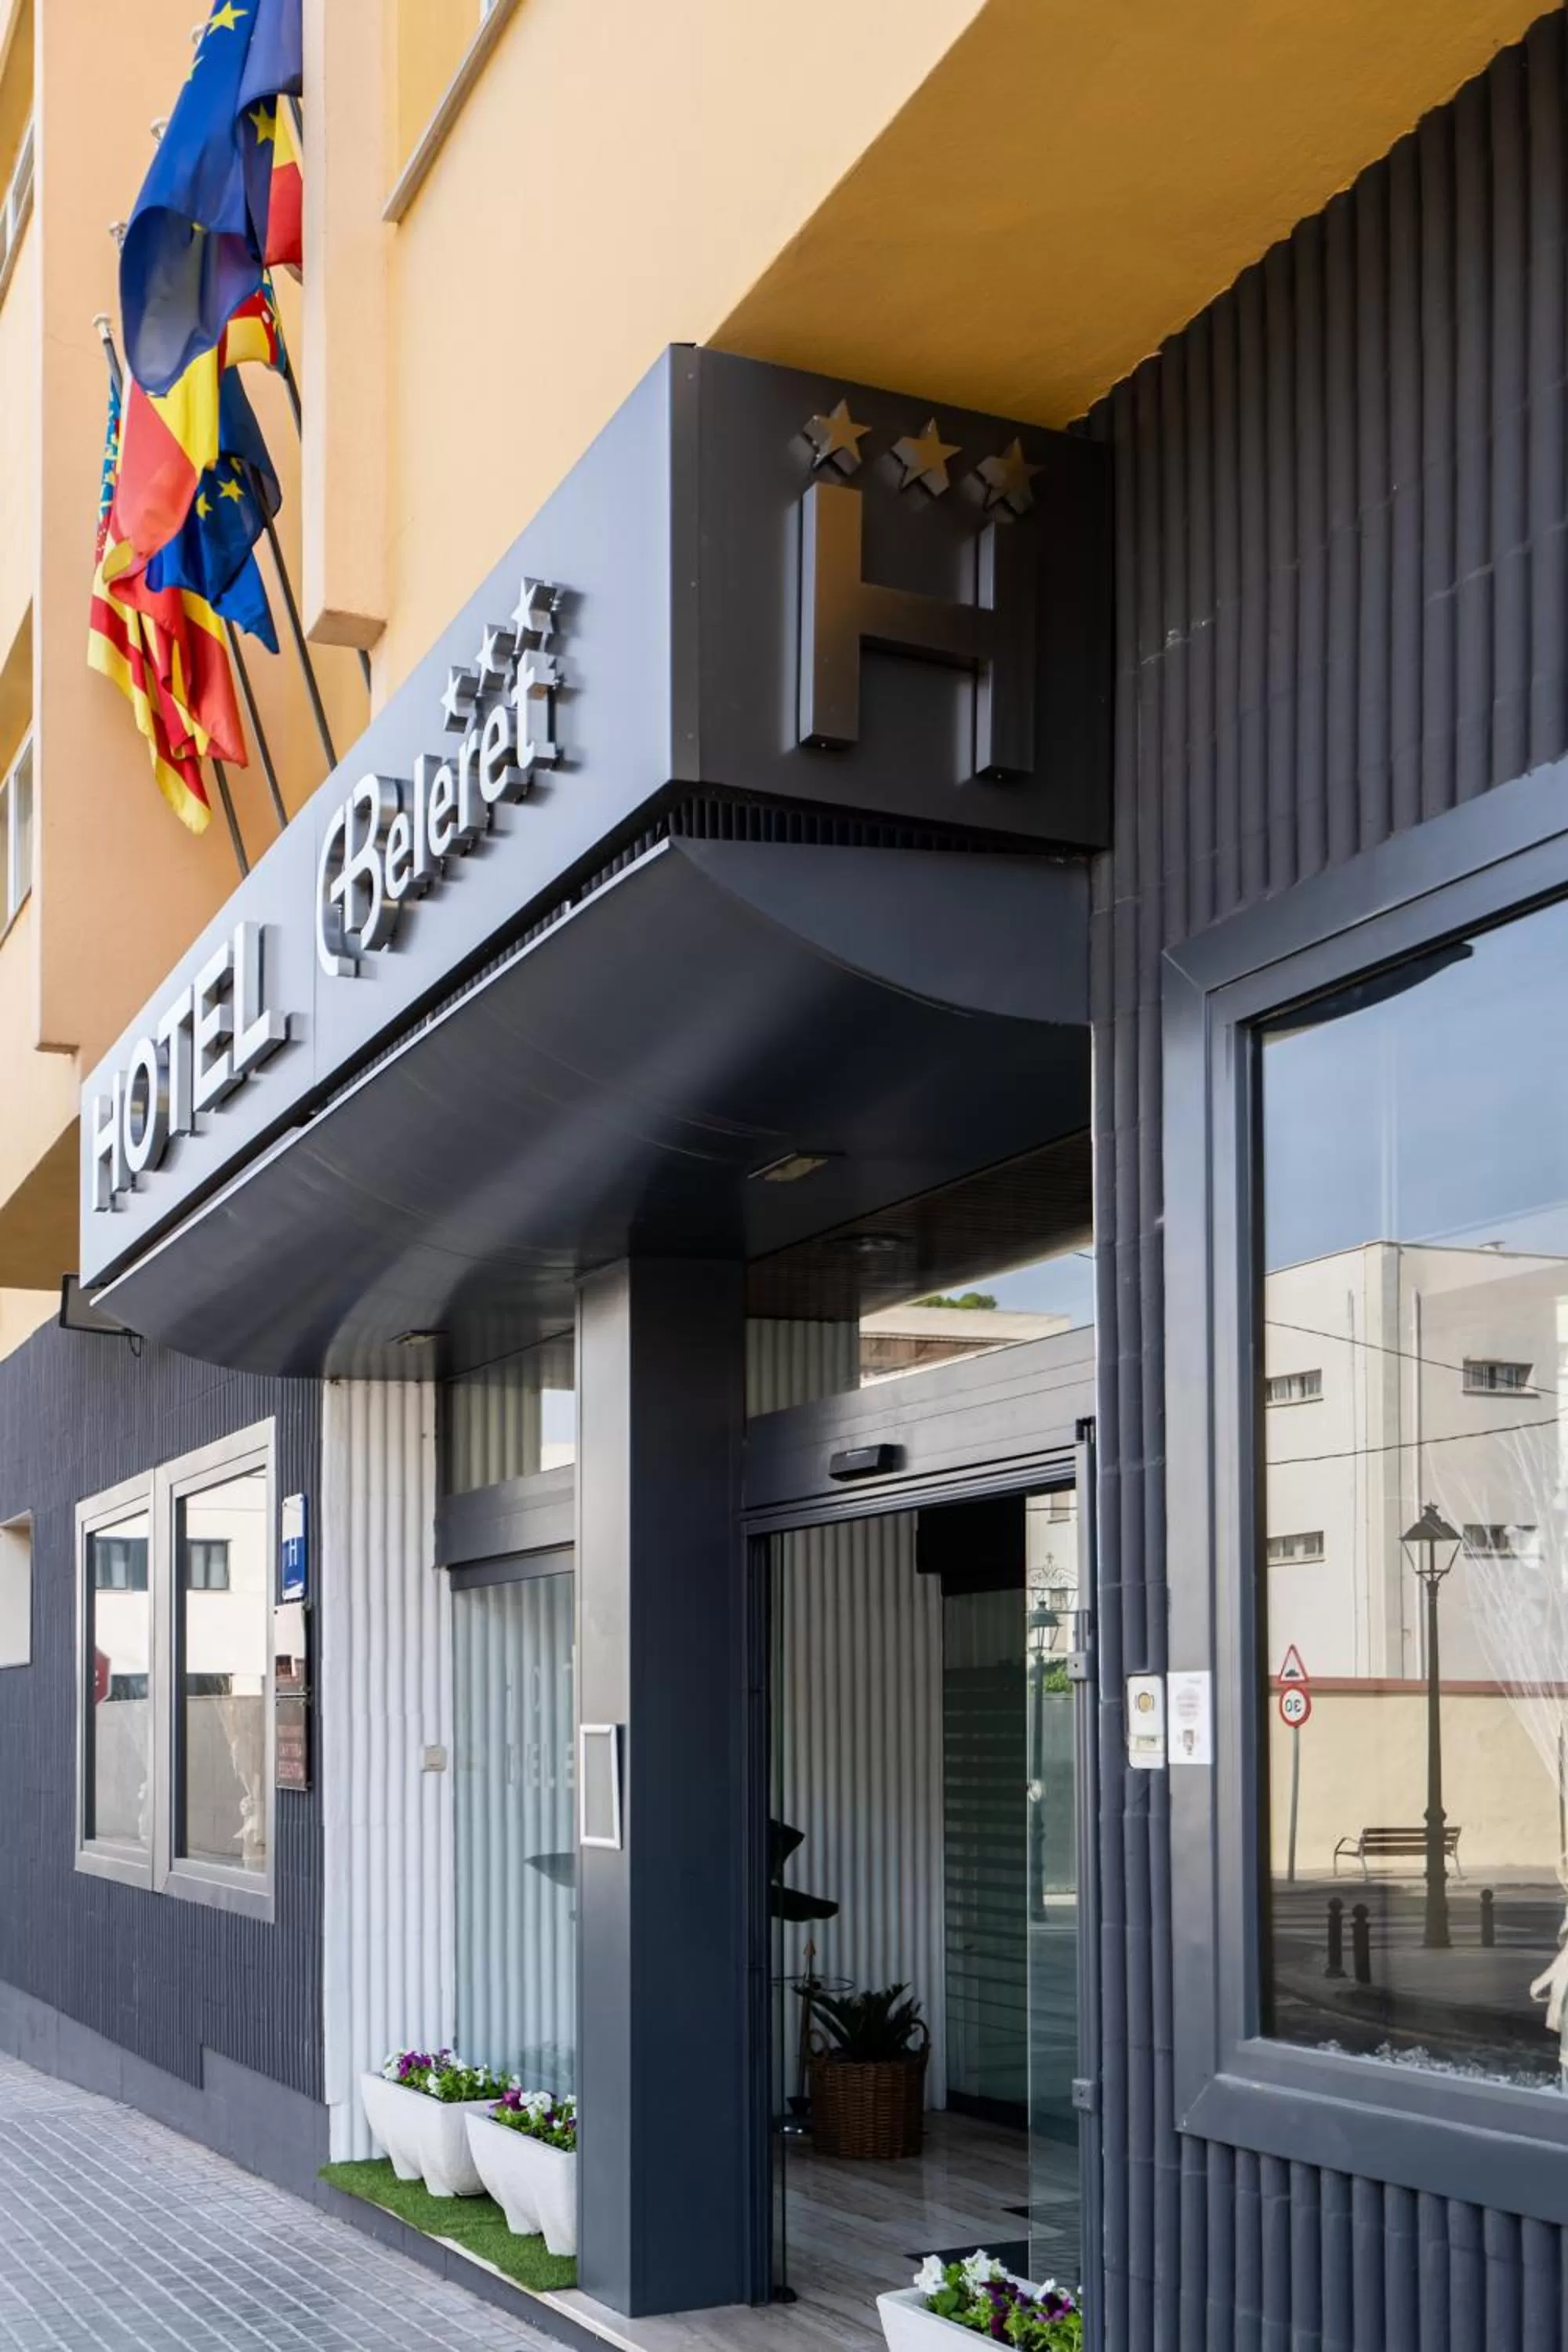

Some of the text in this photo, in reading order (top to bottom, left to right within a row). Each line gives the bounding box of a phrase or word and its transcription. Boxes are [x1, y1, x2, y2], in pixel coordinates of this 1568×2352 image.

[799, 482, 1036, 779] H
[93, 649, 557, 1212] HOTEL Beleret
[288, 1536, 298, 1567] H
